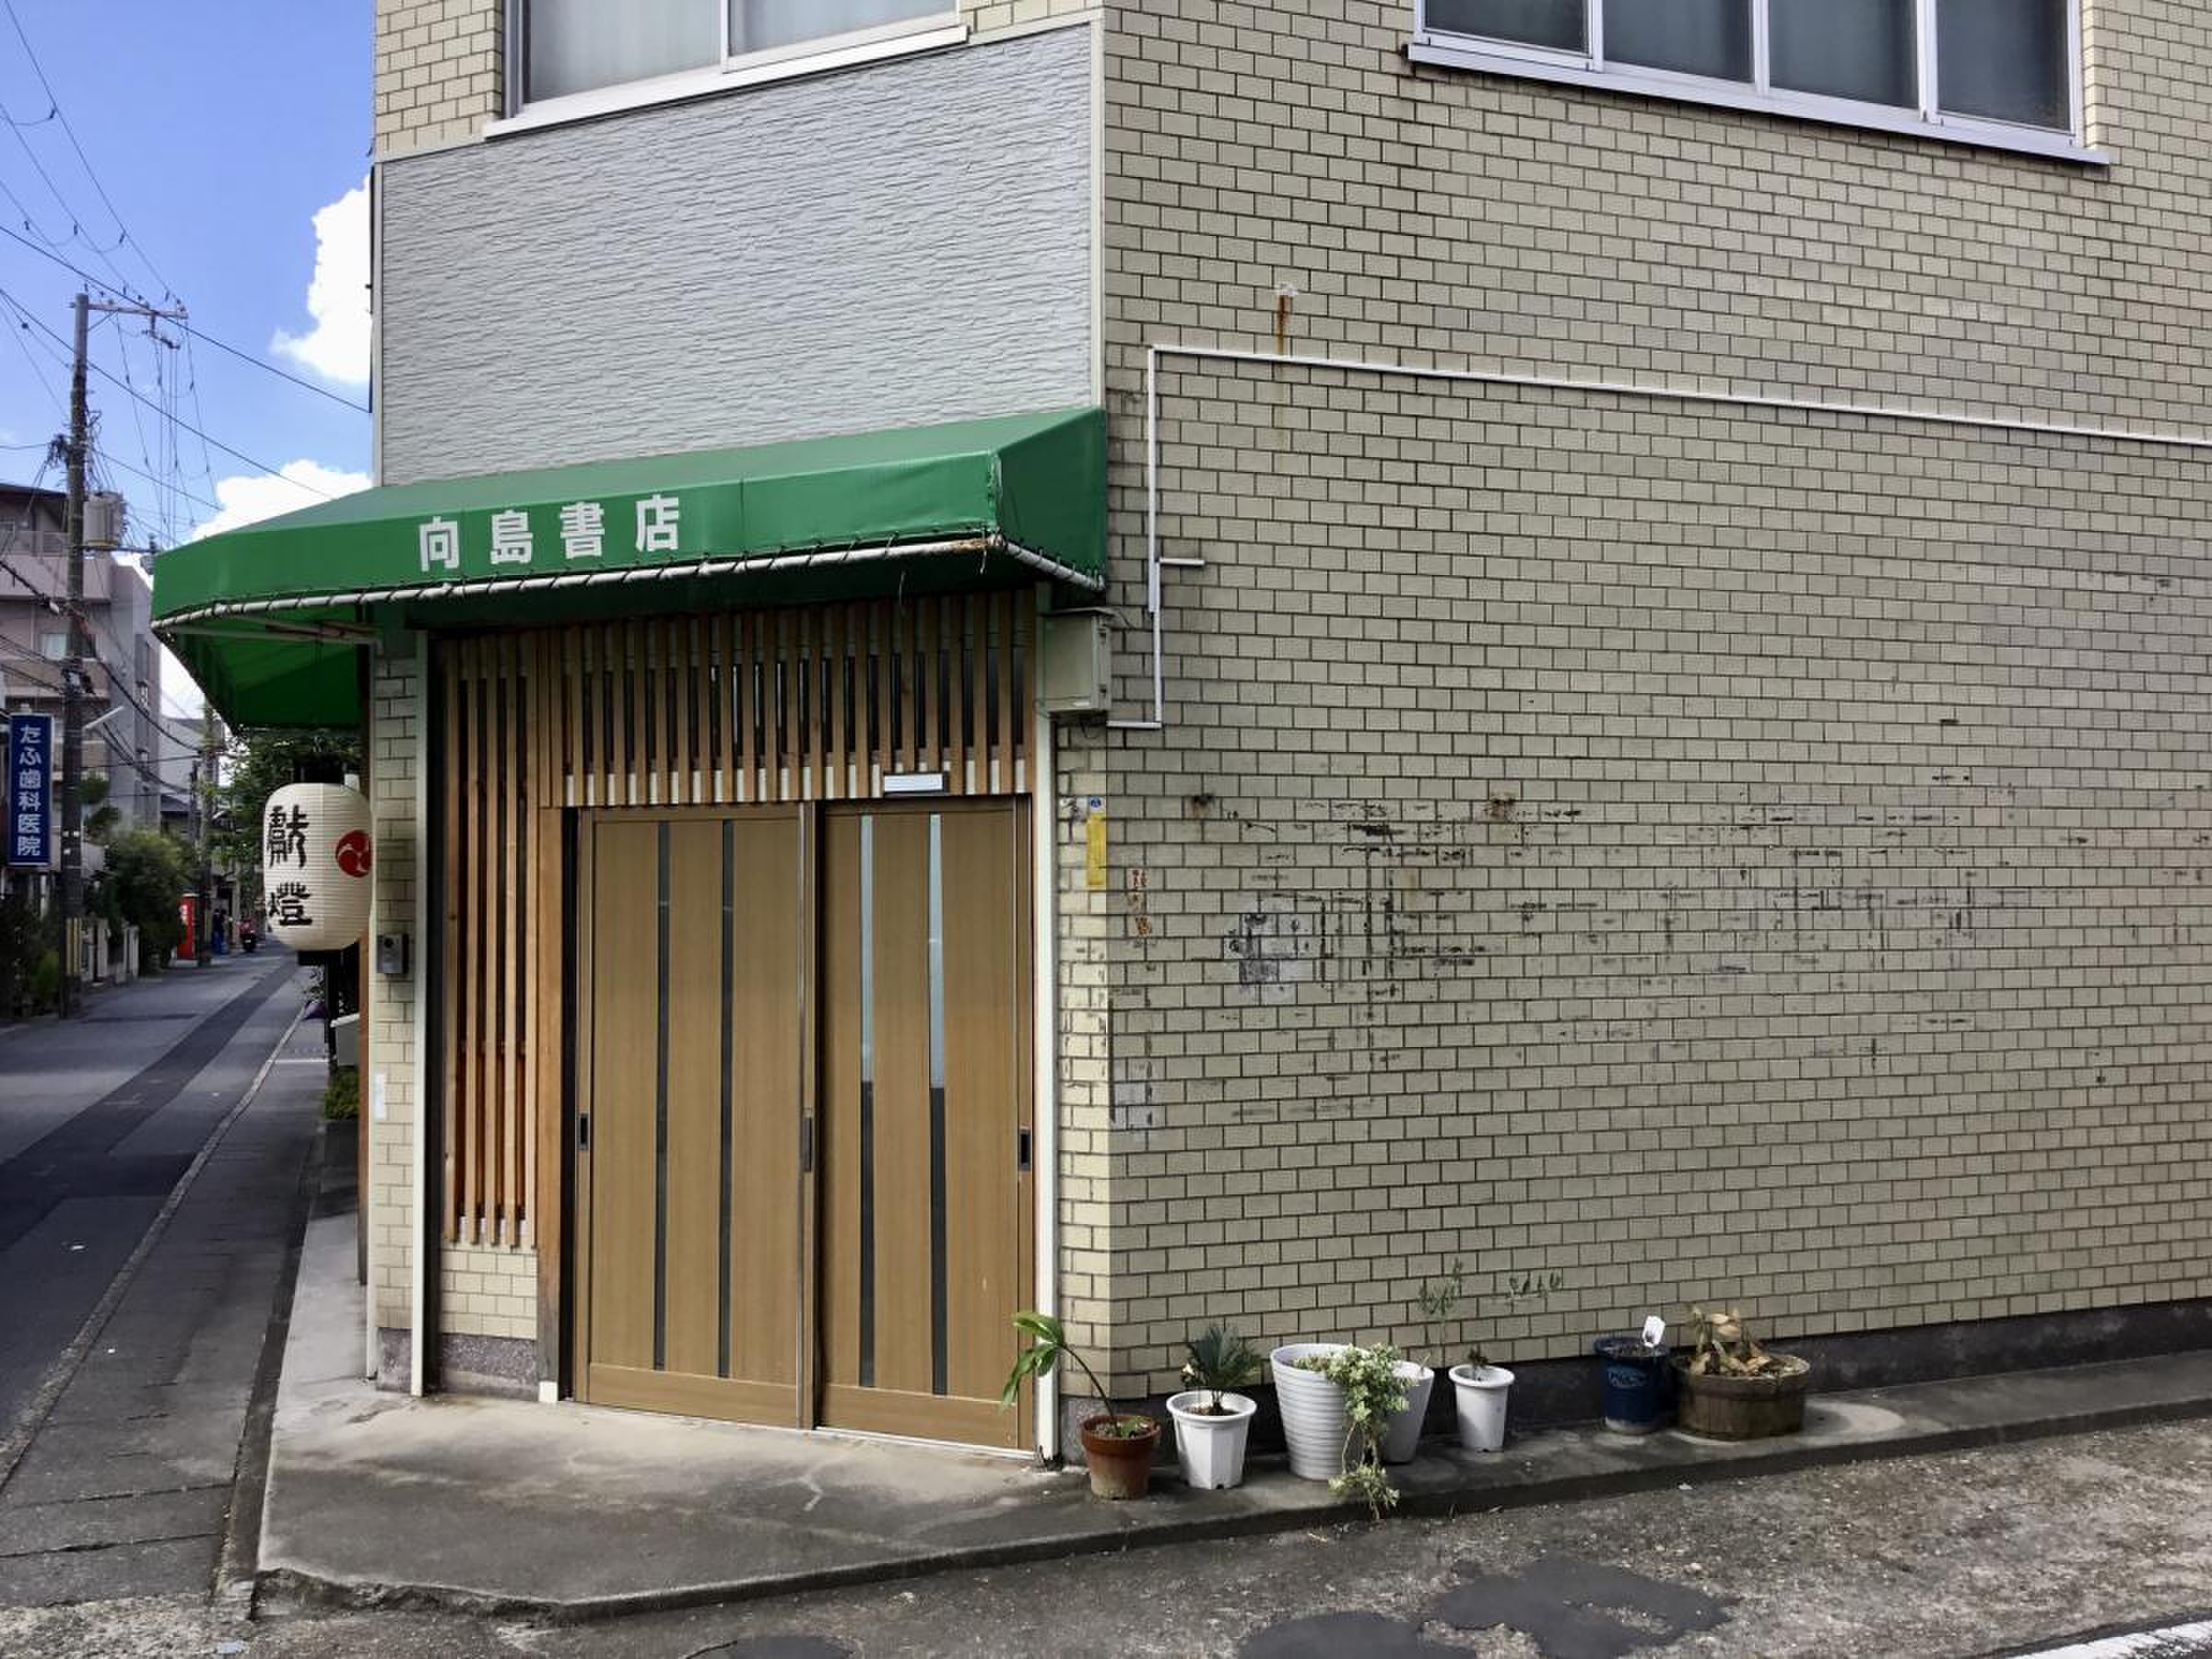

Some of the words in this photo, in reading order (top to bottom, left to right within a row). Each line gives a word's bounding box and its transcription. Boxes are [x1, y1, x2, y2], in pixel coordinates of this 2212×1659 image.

[418, 494, 679, 571] 向島書店
[17, 724, 41, 856] たふ歯科医院
